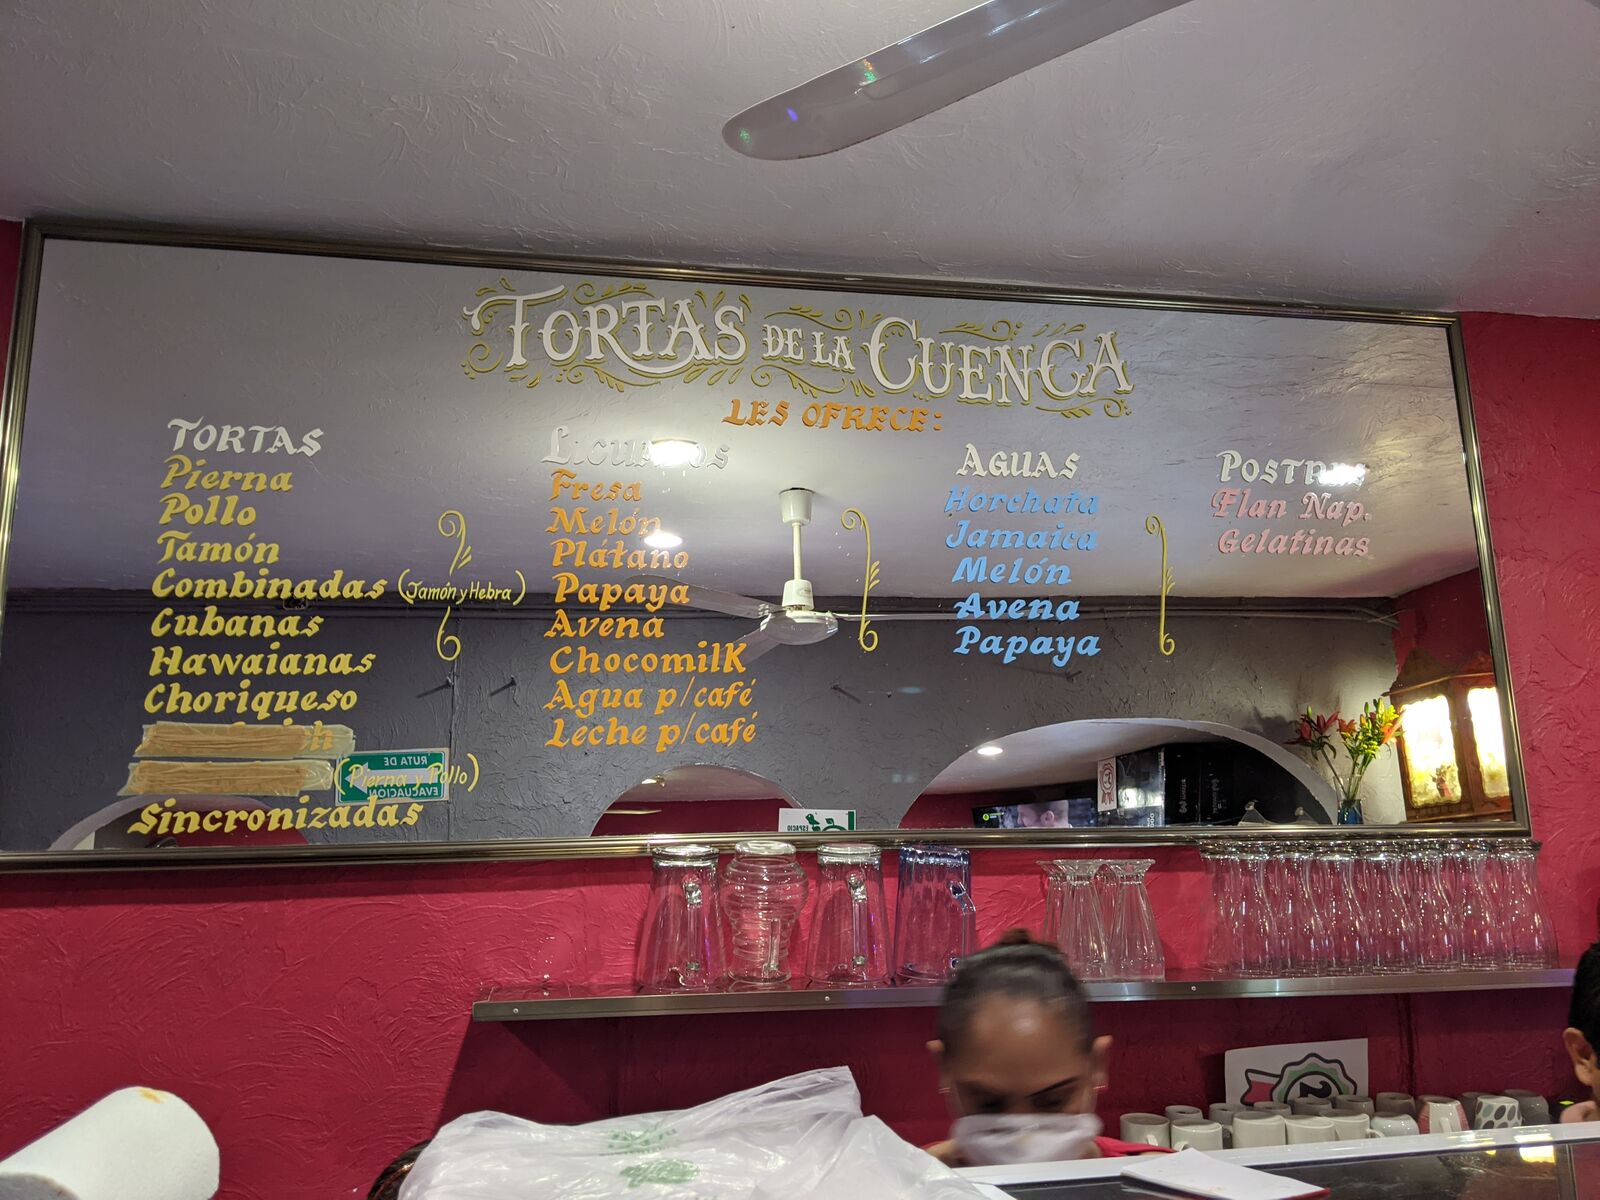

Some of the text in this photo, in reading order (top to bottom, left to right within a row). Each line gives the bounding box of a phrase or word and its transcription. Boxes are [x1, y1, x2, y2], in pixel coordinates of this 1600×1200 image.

[463, 284, 1136, 404] TORTAS DE LA CUENCA
[721, 399, 943, 432] LES OFRECE:
[167, 416, 324, 457] TORTAS
[542, 426, 730, 470] LICUOS
[160, 454, 293, 493] Pierna
[955, 442, 1080, 480] AGUAS
[1215, 450, 1369, 488] POSTRS
[548, 468, 642, 502] Fresa
[943, 484, 1099, 515] Horchata
[157, 492, 257, 527] Pollo
[544, 506, 663, 537] Melón
[1211, 488, 1372, 528] Flan Nap.
[945, 518, 1098, 551] Jamaica
[1217, 528, 1371, 557] Gelatinas
[551, 537, 690, 569] Plátano
[951, 556, 1073, 586] Melón
[150, 567, 388, 601] Combinadas
[455, 587, 468, 605] y
[551, 572, 691, 613] Papaya
[150, 606, 325, 638] Cubanas
[543, 608, 665, 639] Avena
[952, 592, 1081, 622] Avena
[148, 642, 376, 677] Hawaianas
[952, 625, 1102, 668] Papaya
[143, 679, 358, 721] Choriqueso
[543, 675, 757, 719] Agua p/café
[544, 711, 758, 753] Leche p/café
[412, 772, 424, 791] y
[127, 795, 424, 837] Sincronizadas
